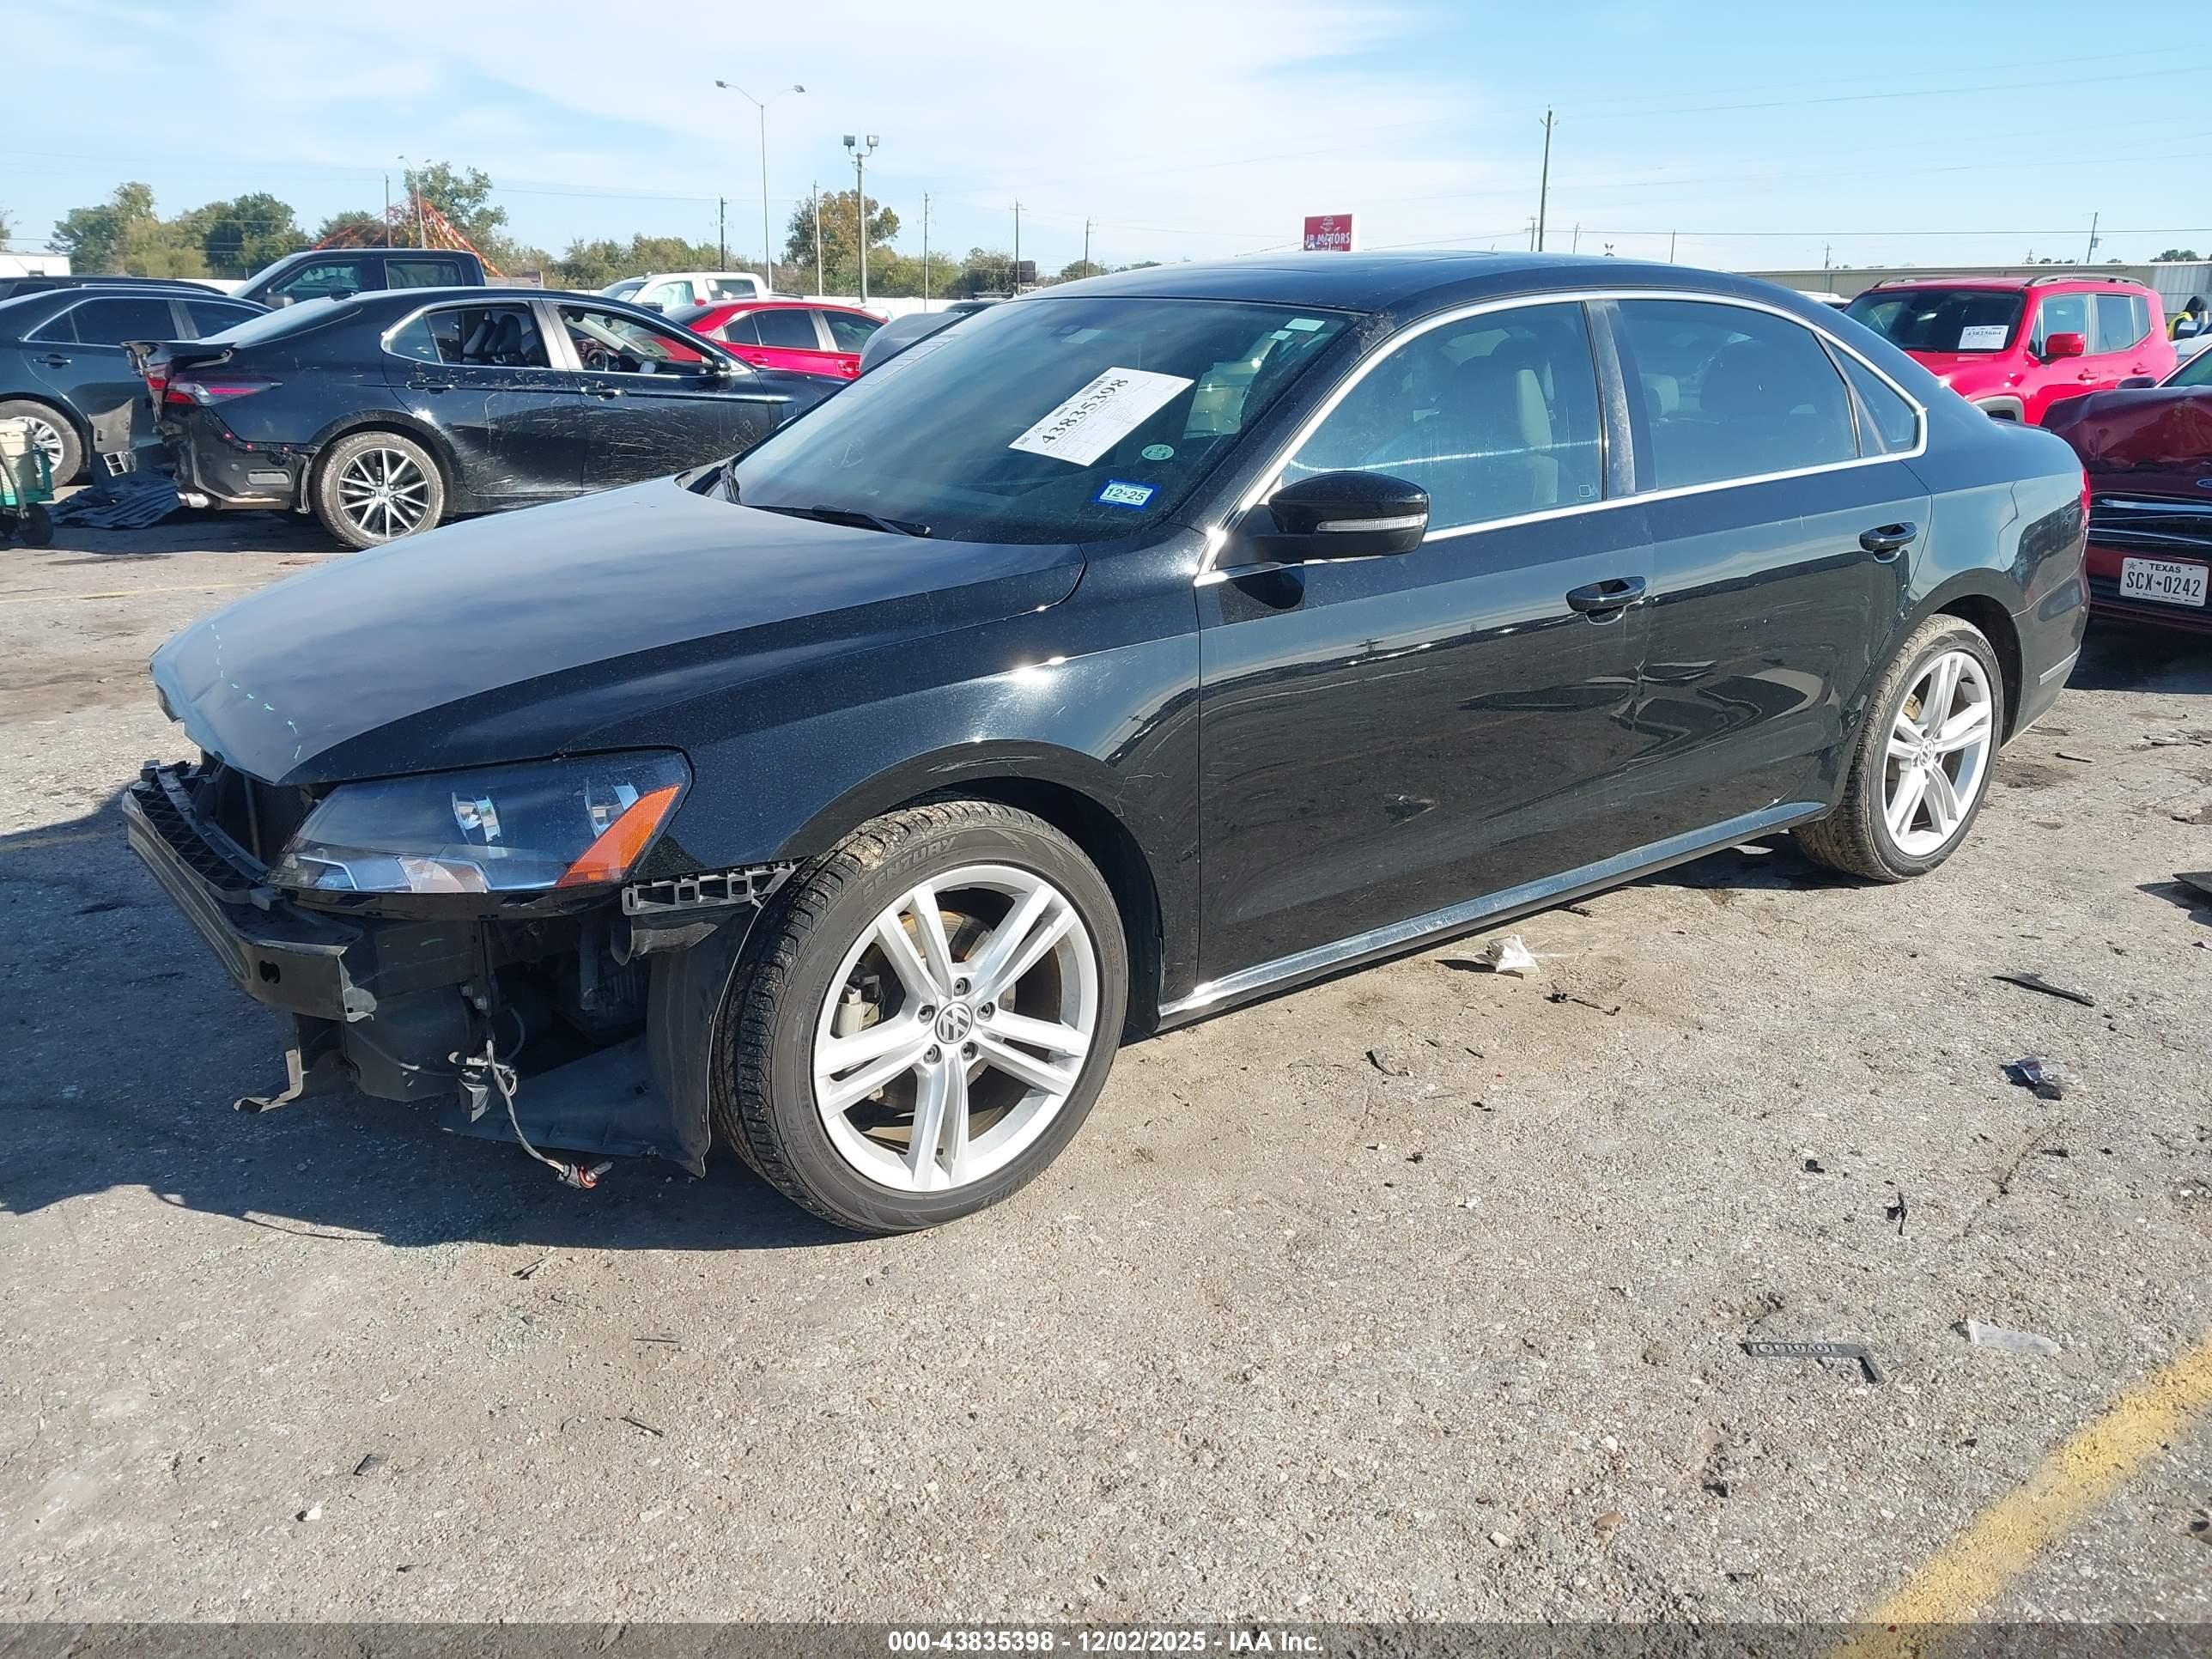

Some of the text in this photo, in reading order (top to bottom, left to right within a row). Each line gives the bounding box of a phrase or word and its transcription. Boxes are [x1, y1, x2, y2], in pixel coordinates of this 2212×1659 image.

[1042, 379, 1129, 444] 43835398
[1106, 488, 1123, 497] 12
[1127, 490, 1146, 501] 25
[2148, 562, 2182, 574] TEXAS
[861, 836, 957, 902] SENTURY
